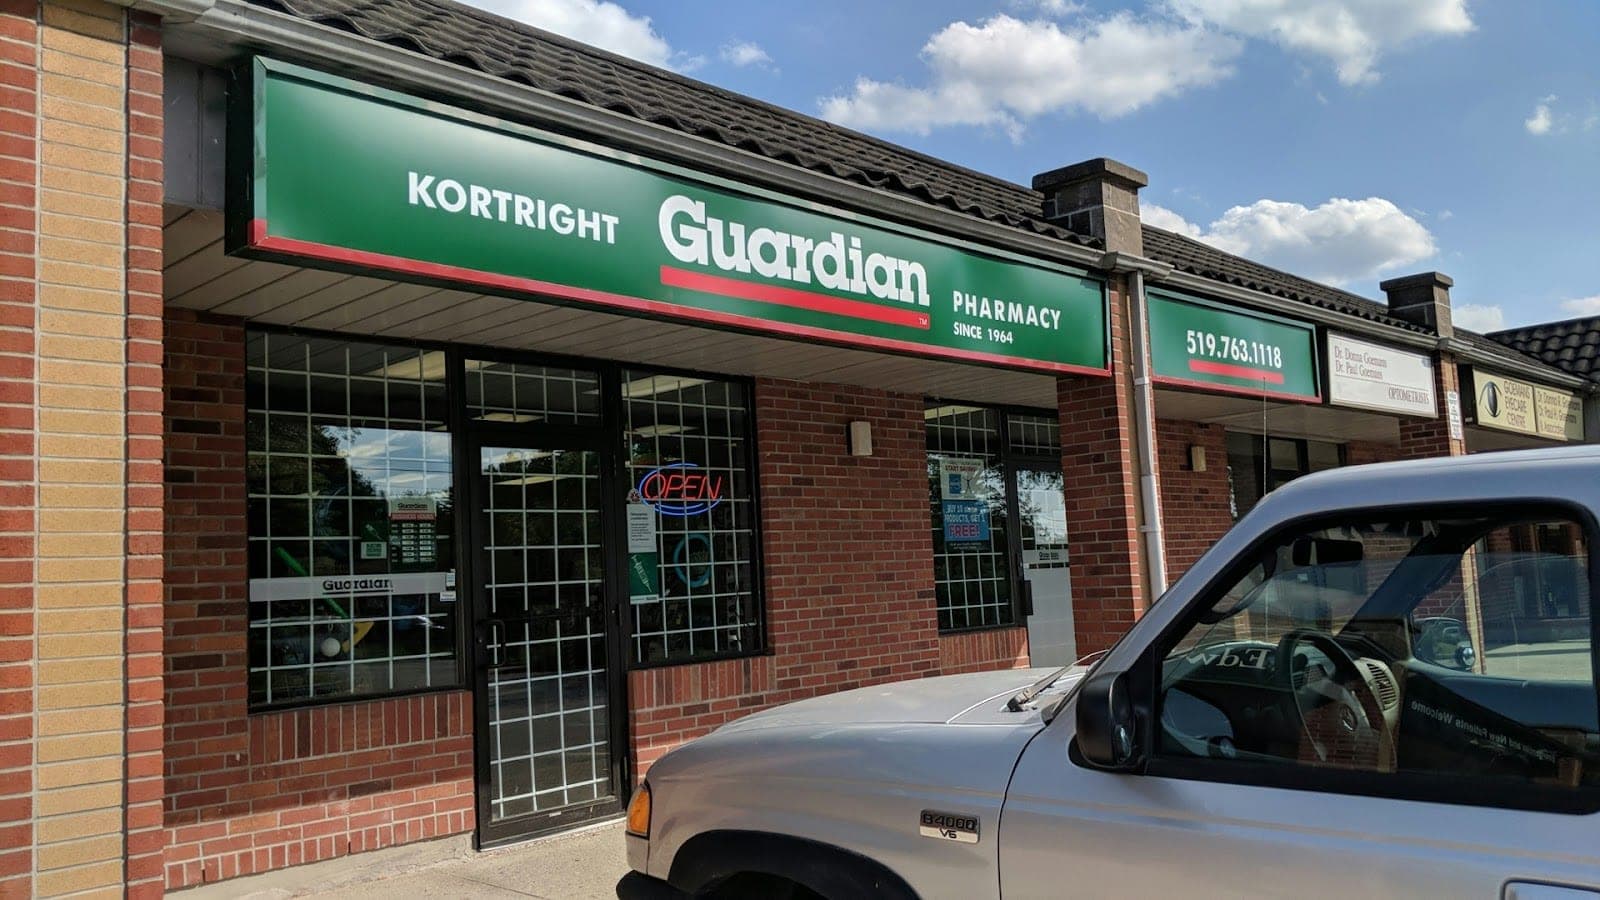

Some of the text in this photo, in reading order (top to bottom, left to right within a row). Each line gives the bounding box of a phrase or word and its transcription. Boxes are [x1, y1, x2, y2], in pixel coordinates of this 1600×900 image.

[408, 171, 619, 244] KORTRIGHT
[658, 195, 930, 307] Guardian
[952, 290, 1062, 330] PHARMACY
[953, 322, 1013, 344] SINCE 1964
[1186, 330, 1283, 369] 519.763.1118
[1334, 345, 1344, 359] Dr.
[1335, 359, 1345, 374] Dr.
[1346, 361, 1359, 375] Paul
[1388, 386, 1430, 405] OPTOMETRISTS
[1507, 412, 1526, 428] CENTRE
[643, 473, 722, 501] OPEN
[949, 523, 979, 537] FREE!
[923, 813, 976, 831] B4000
[939, 827, 957, 839] V6
